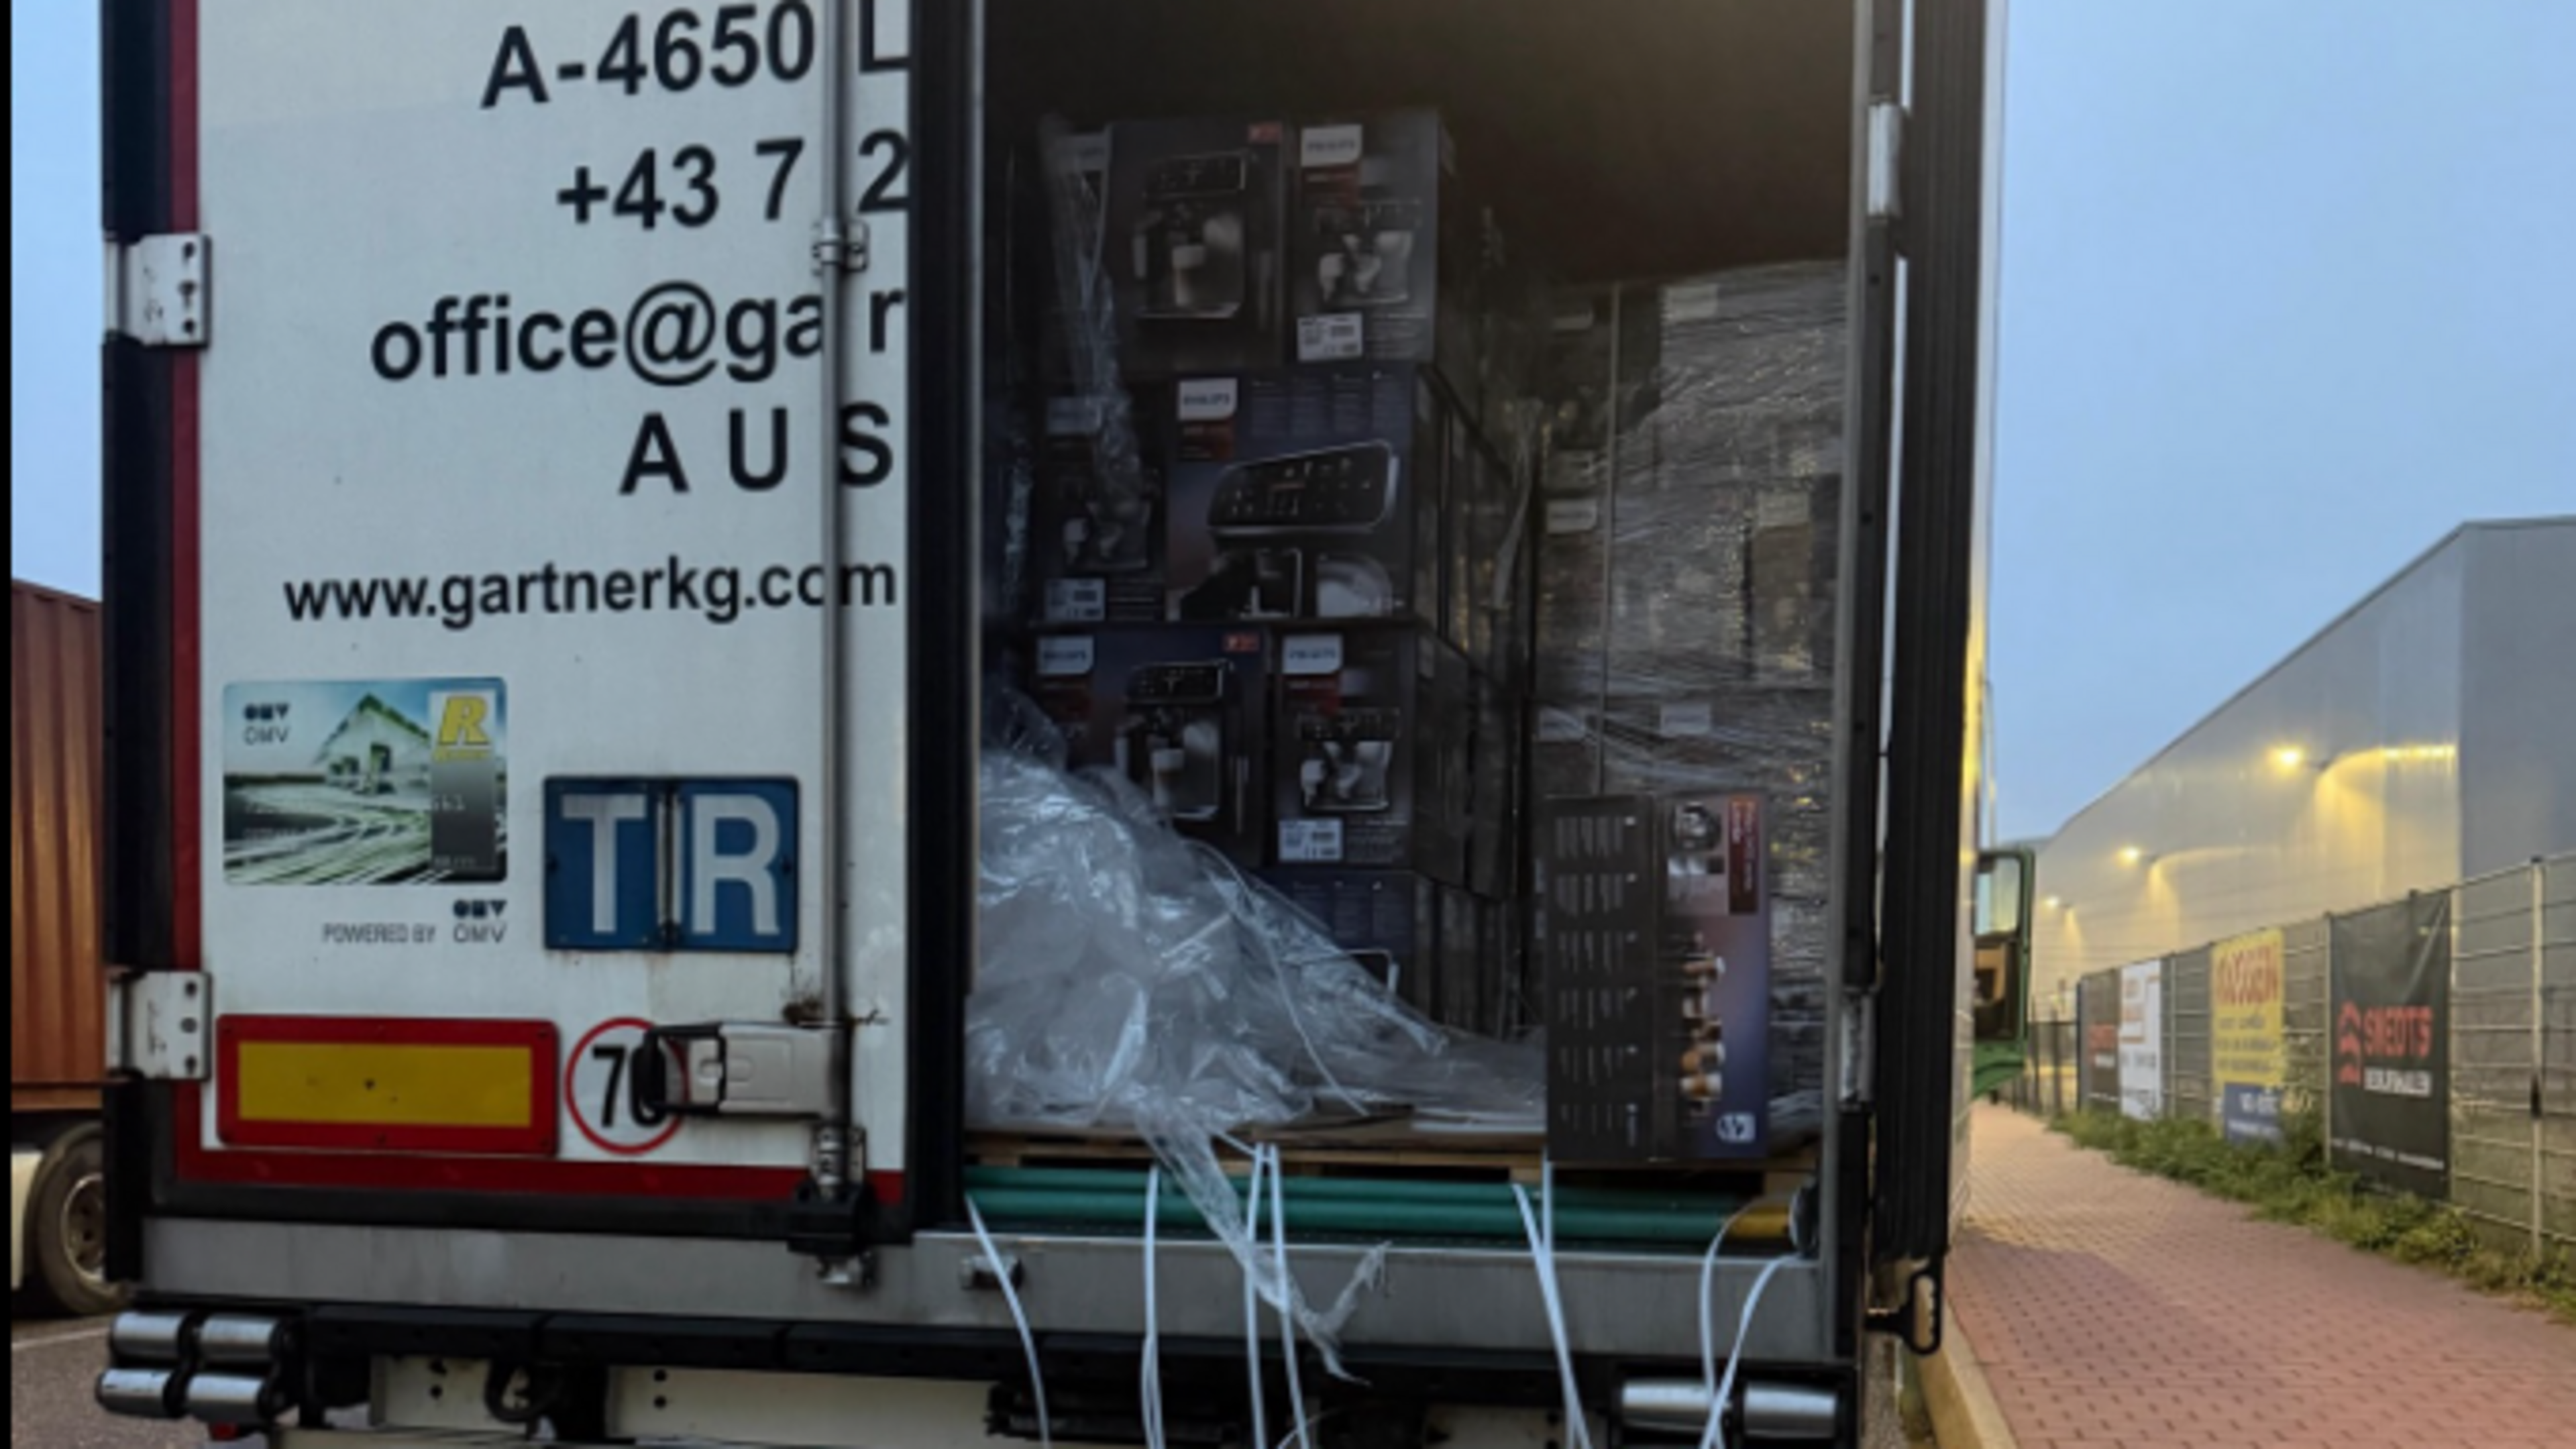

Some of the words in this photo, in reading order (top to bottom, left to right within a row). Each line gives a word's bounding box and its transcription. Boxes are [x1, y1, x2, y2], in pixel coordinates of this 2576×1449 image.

[481, 0, 814, 108] A-4650
[283, 555, 896, 629] www.gartnerkg.com
[244, 727, 288, 745] OMV
[323, 924, 408, 943] POWERED
[413, 924, 436, 943] BY
[453, 923, 506, 943] OMV
